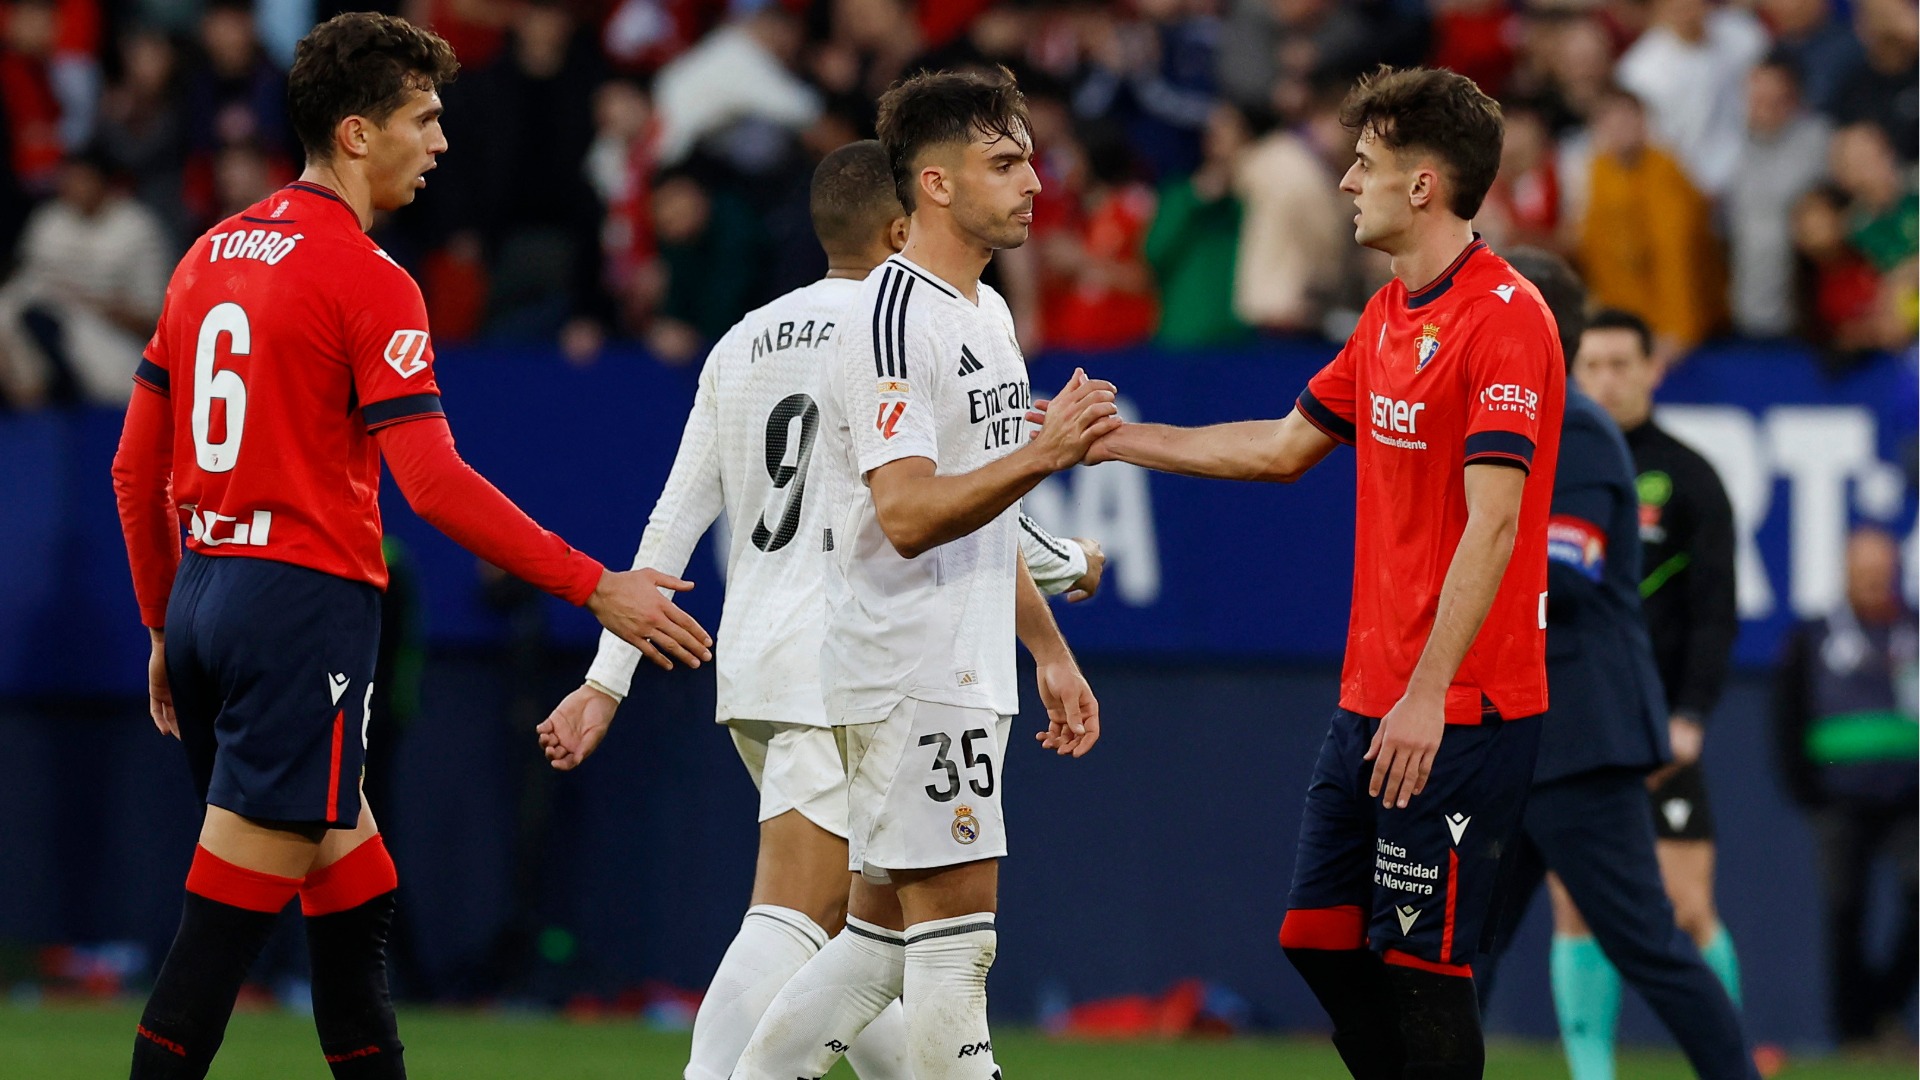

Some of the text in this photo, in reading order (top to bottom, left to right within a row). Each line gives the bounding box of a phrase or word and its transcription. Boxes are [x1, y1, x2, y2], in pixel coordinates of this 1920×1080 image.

[209, 229, 304, 266] TORRÓ
[191, 302, 251, 474] 6
[750, 393, 820, 553] 9
[917, 728, 995, 802] 35
[1382, 872, 1433, 895] Navarra
